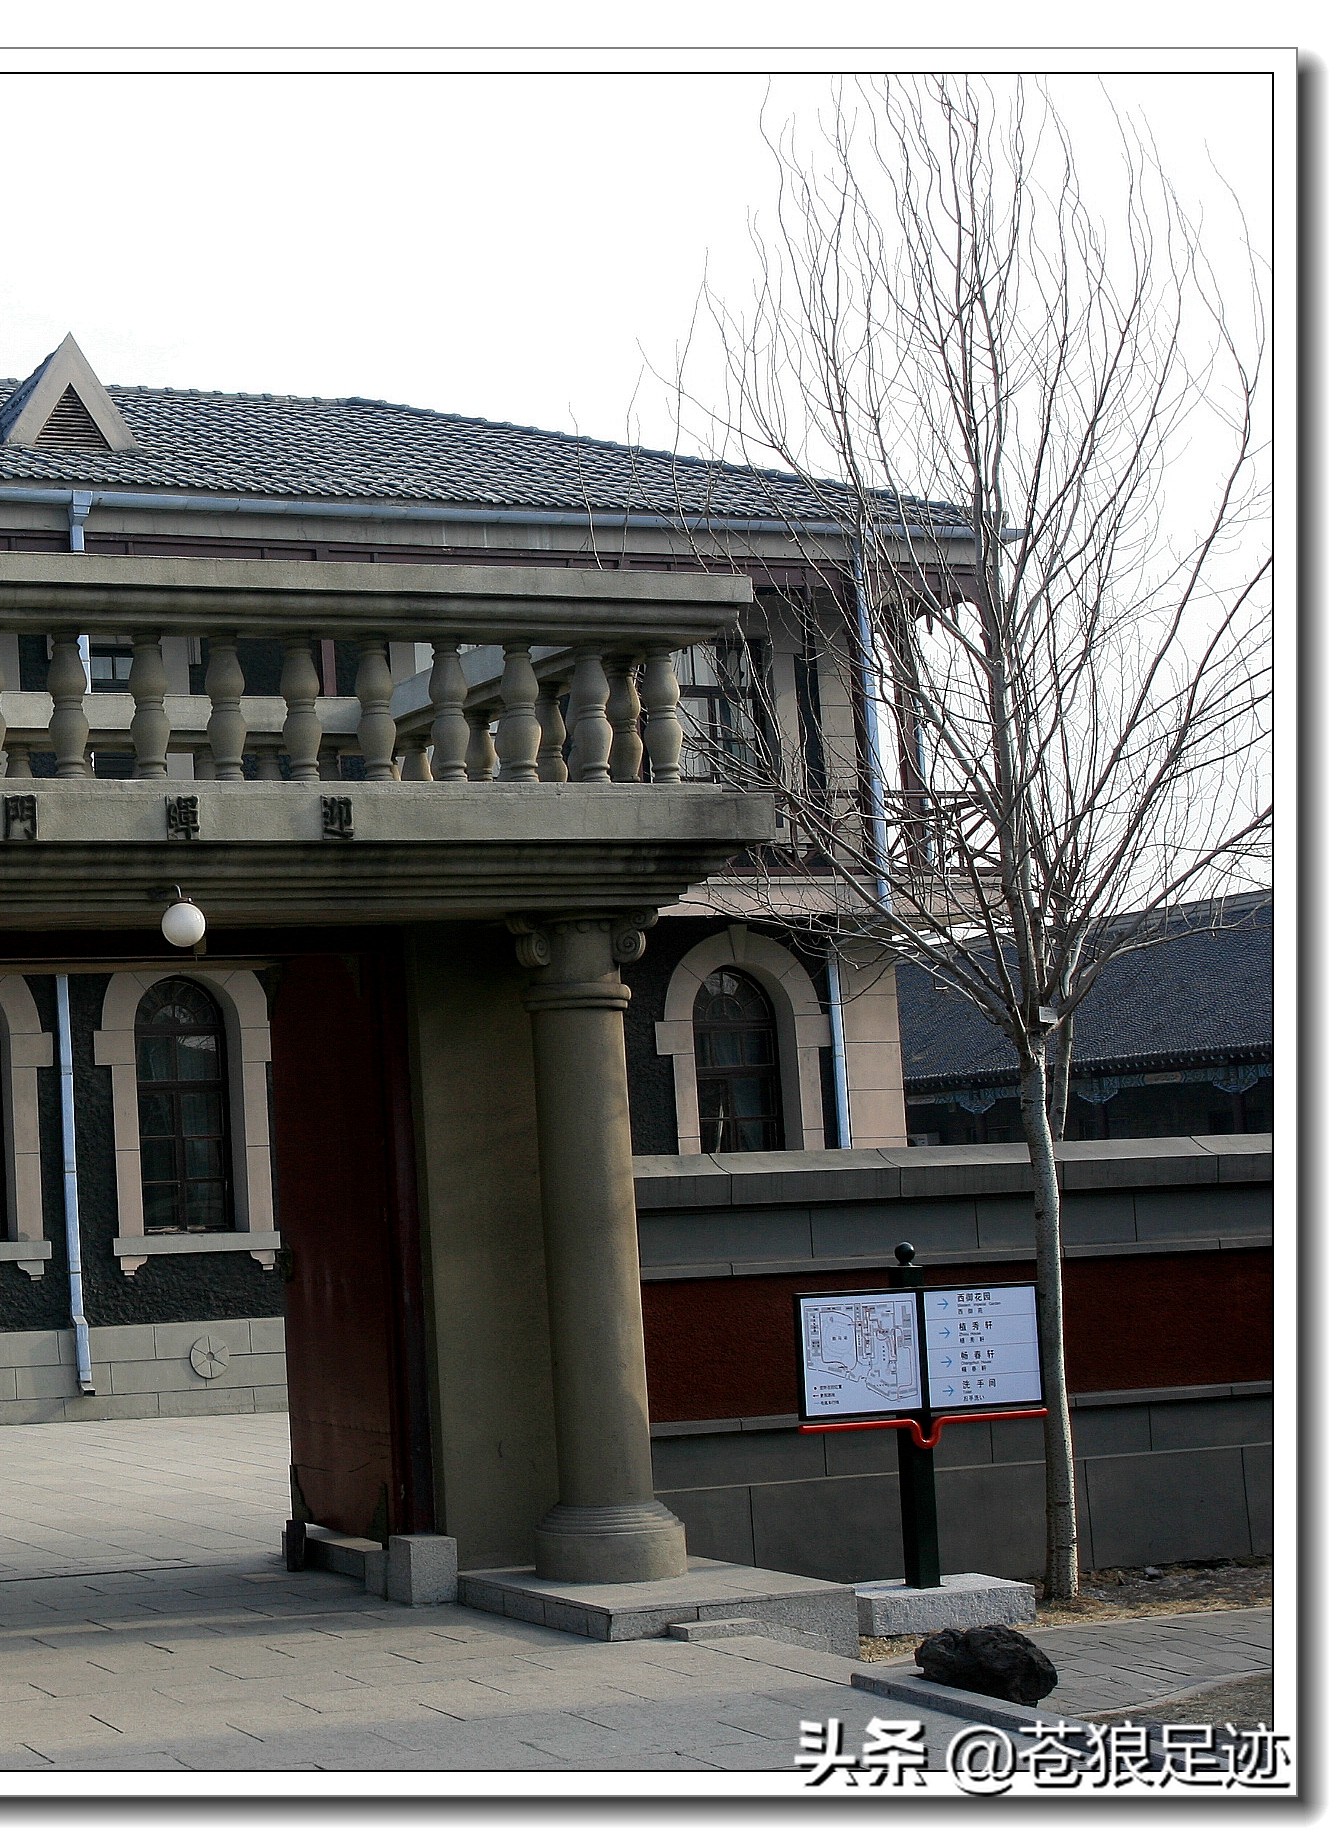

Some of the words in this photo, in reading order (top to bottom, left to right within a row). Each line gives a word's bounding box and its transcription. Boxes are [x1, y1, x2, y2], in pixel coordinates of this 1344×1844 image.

[957, 1292, 991, 1302] 西御花园
[962, 1378, 996, 1389] 洗手间
